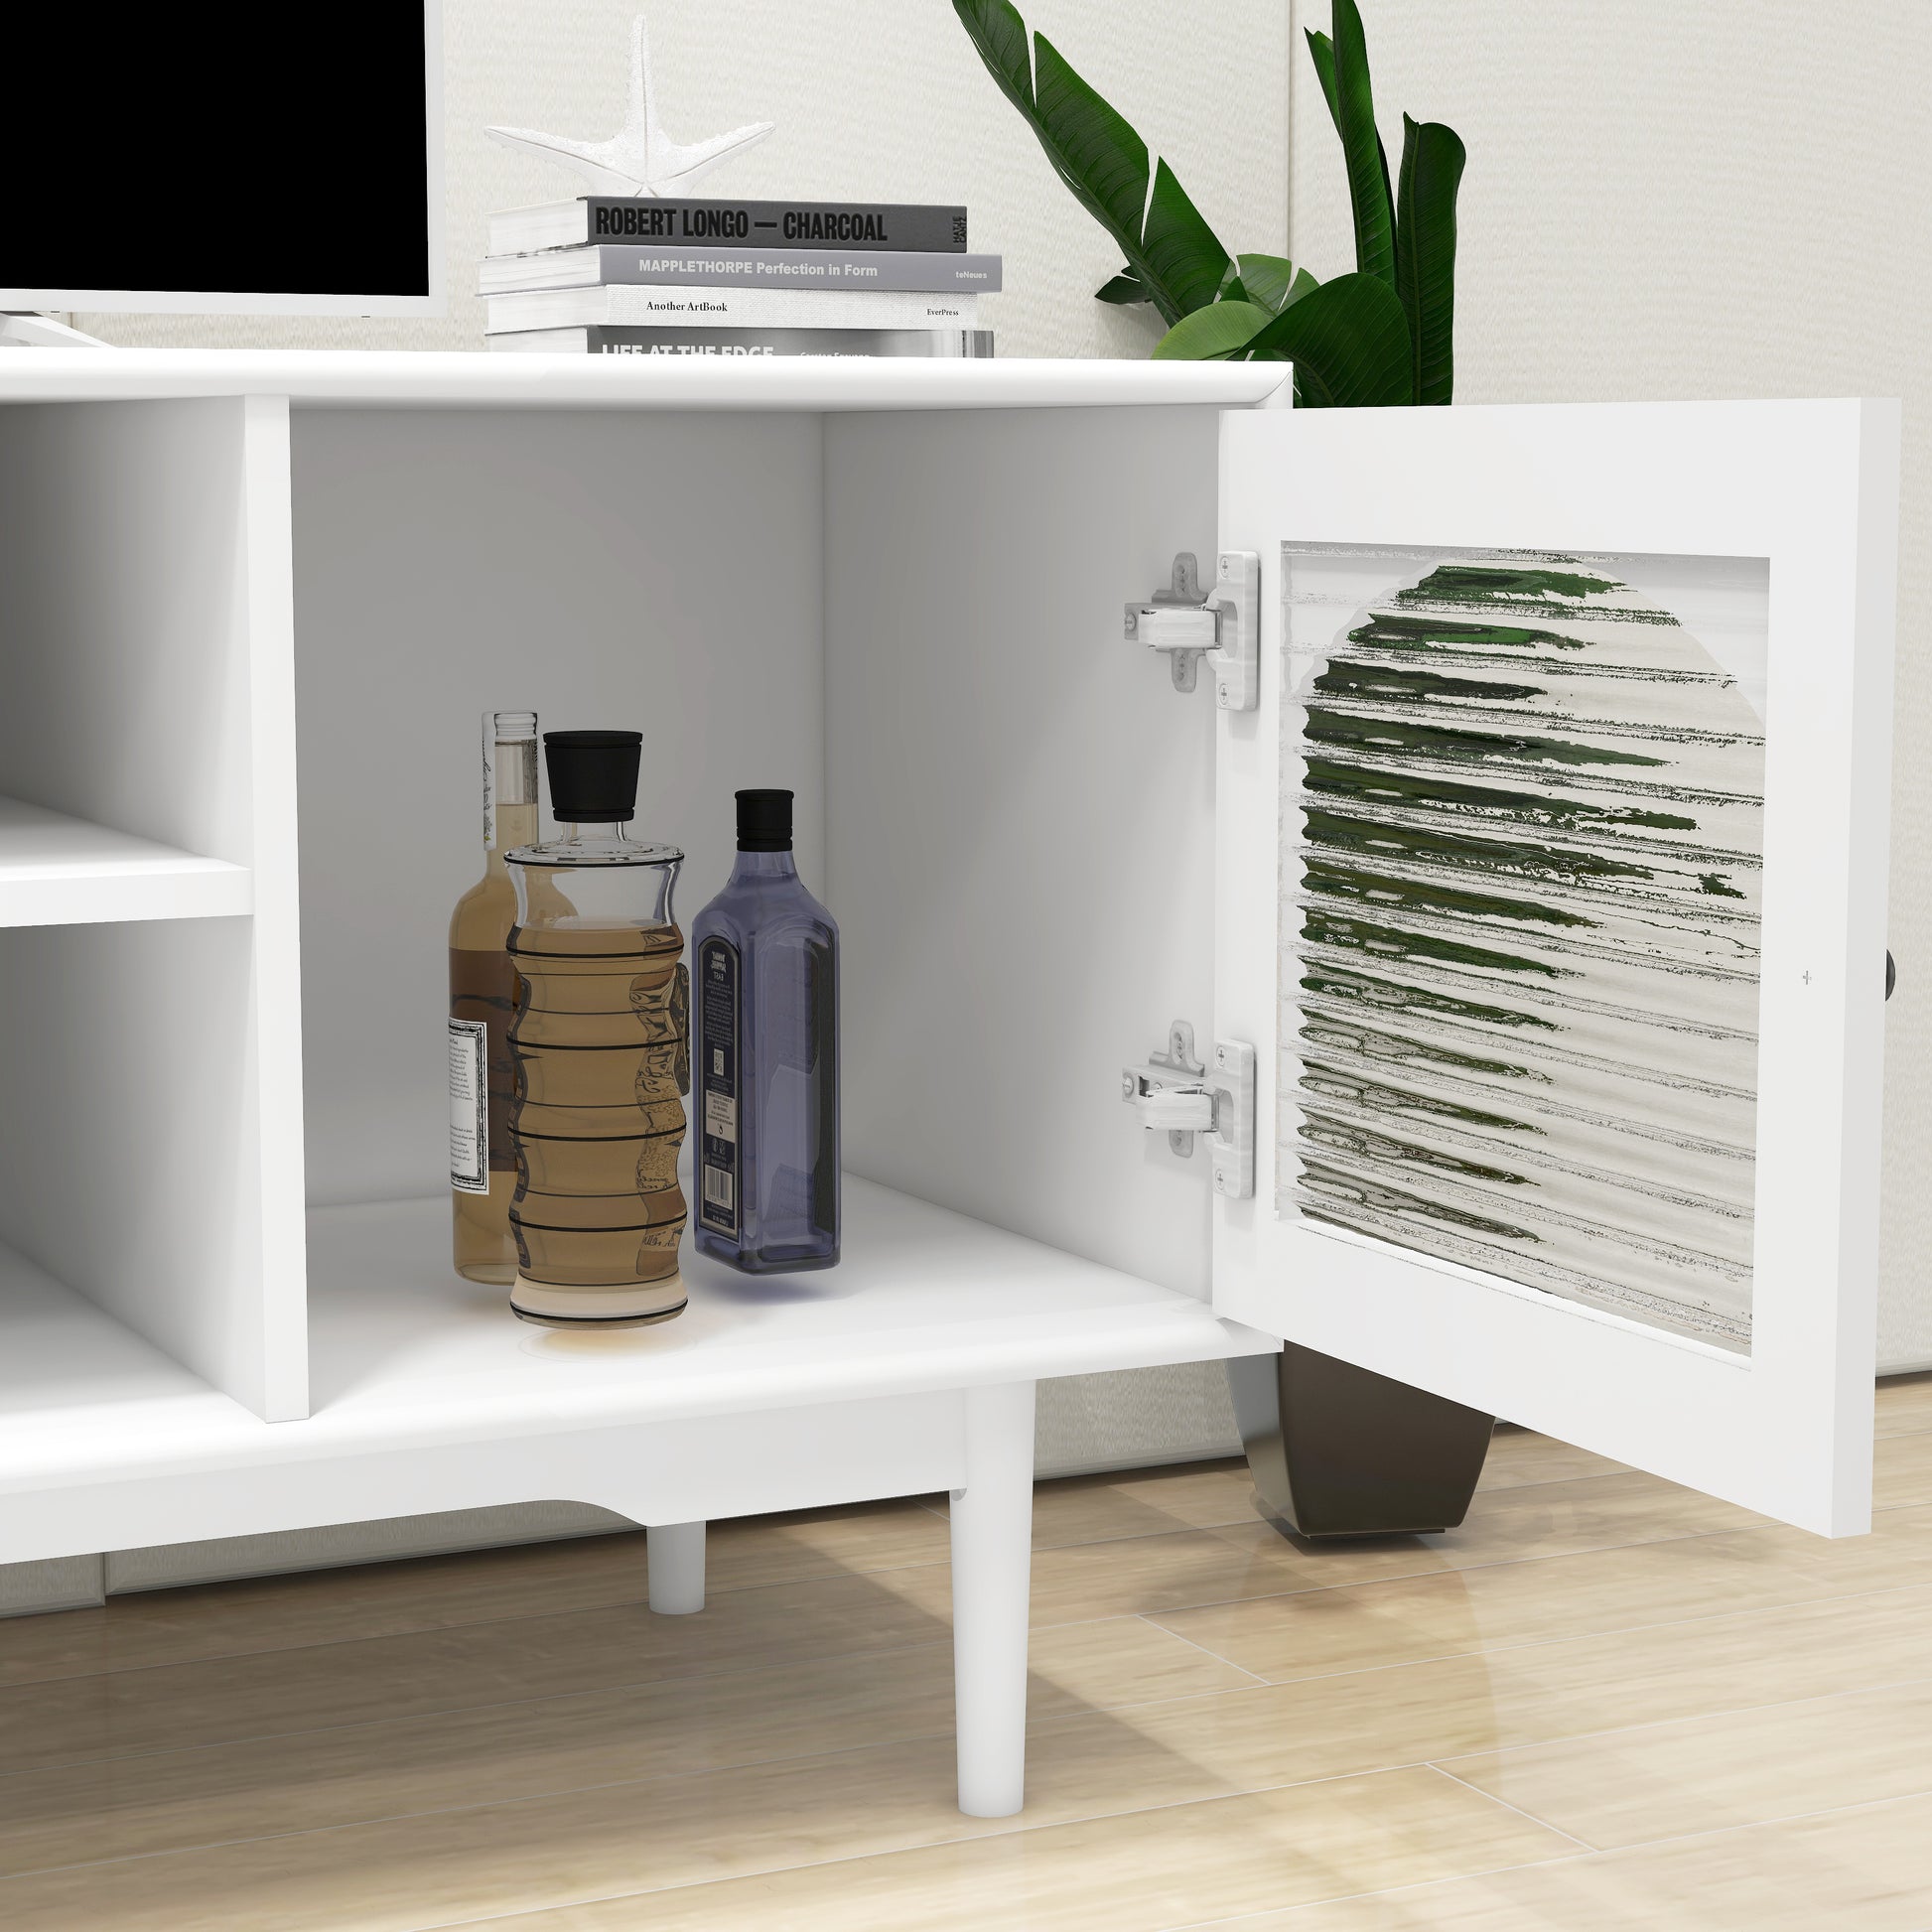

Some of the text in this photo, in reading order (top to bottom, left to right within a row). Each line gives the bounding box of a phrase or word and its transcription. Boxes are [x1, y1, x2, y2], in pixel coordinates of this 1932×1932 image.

[596, 207, 676, 236] ROBERT
[683, 208, 748, 238] LONGO
[783, 211, 888, 241] CHARCOAL
[638, 259, 878, 277] MAPPLETHORPE Perfection in Form
[646, 301, 728, 312] Another ArtBook
